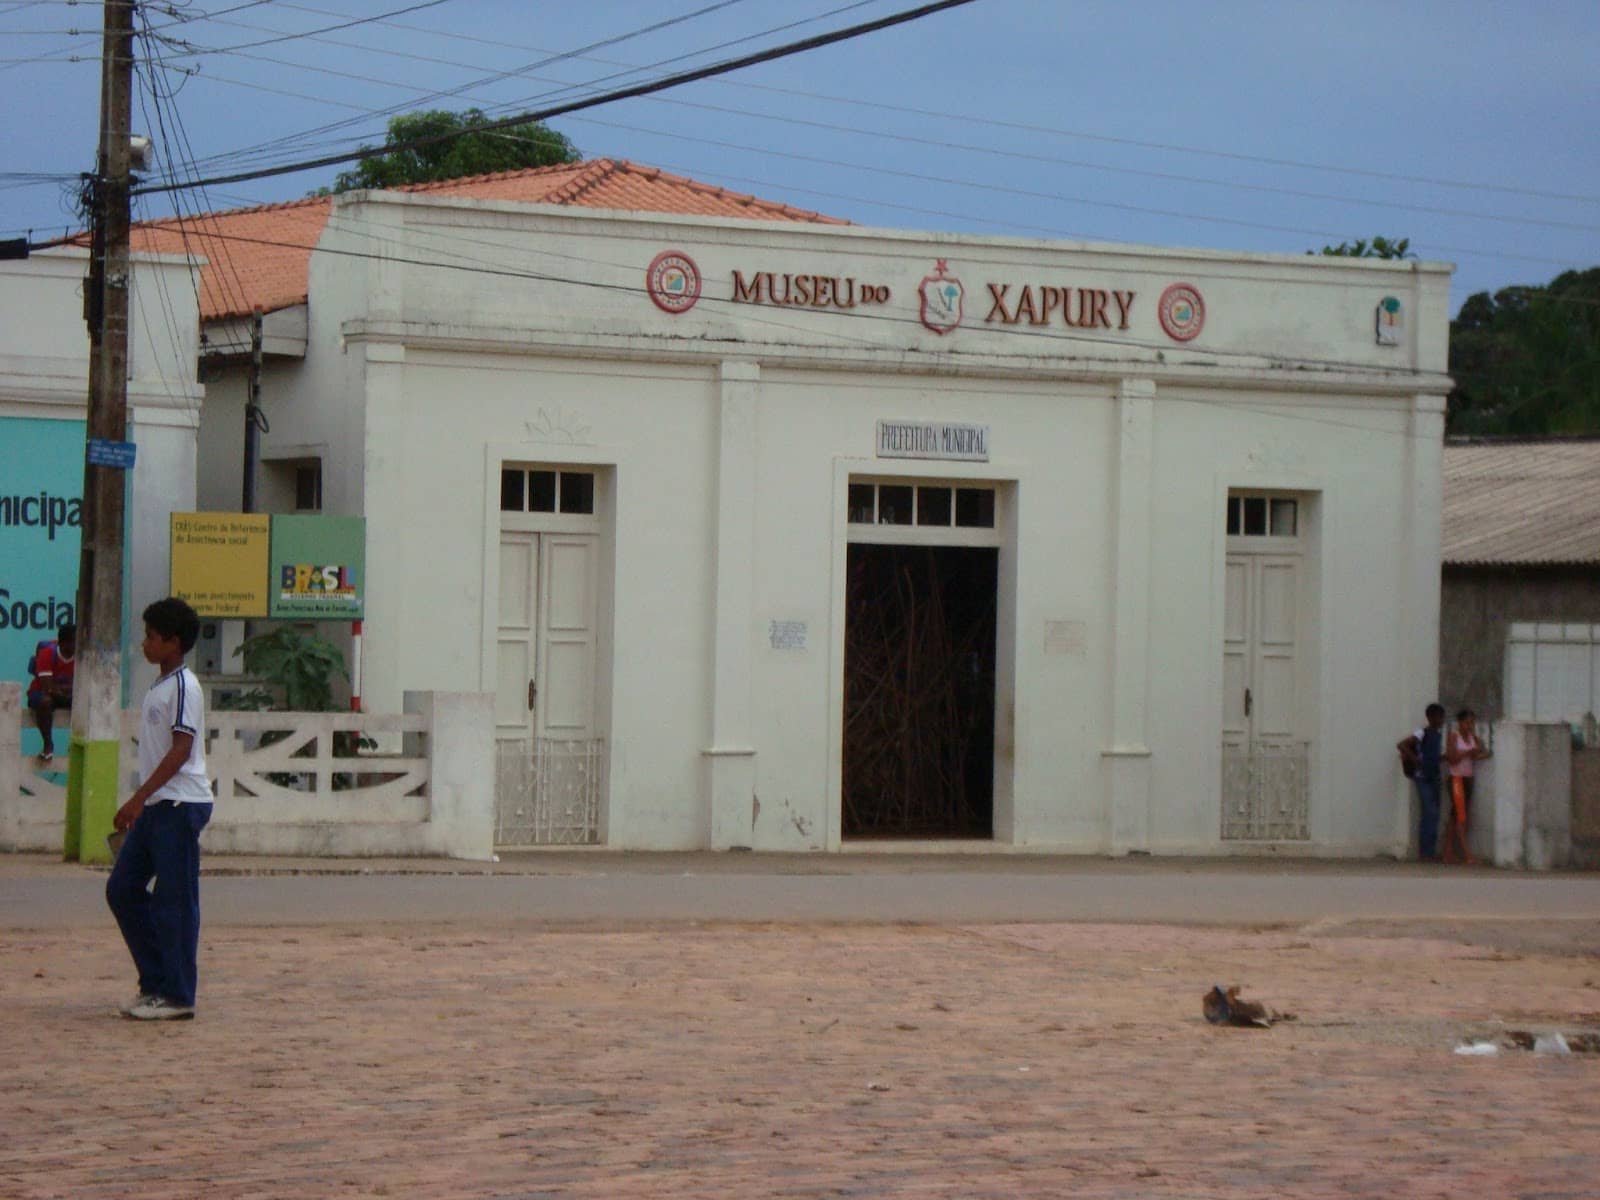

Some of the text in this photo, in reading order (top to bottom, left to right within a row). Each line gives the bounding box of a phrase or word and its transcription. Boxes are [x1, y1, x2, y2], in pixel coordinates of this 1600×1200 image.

[731, 269, 857, 309] MUSEU
[860, 283, 891, 304] DO
[984, 283, 1137, 330] XAPURY
